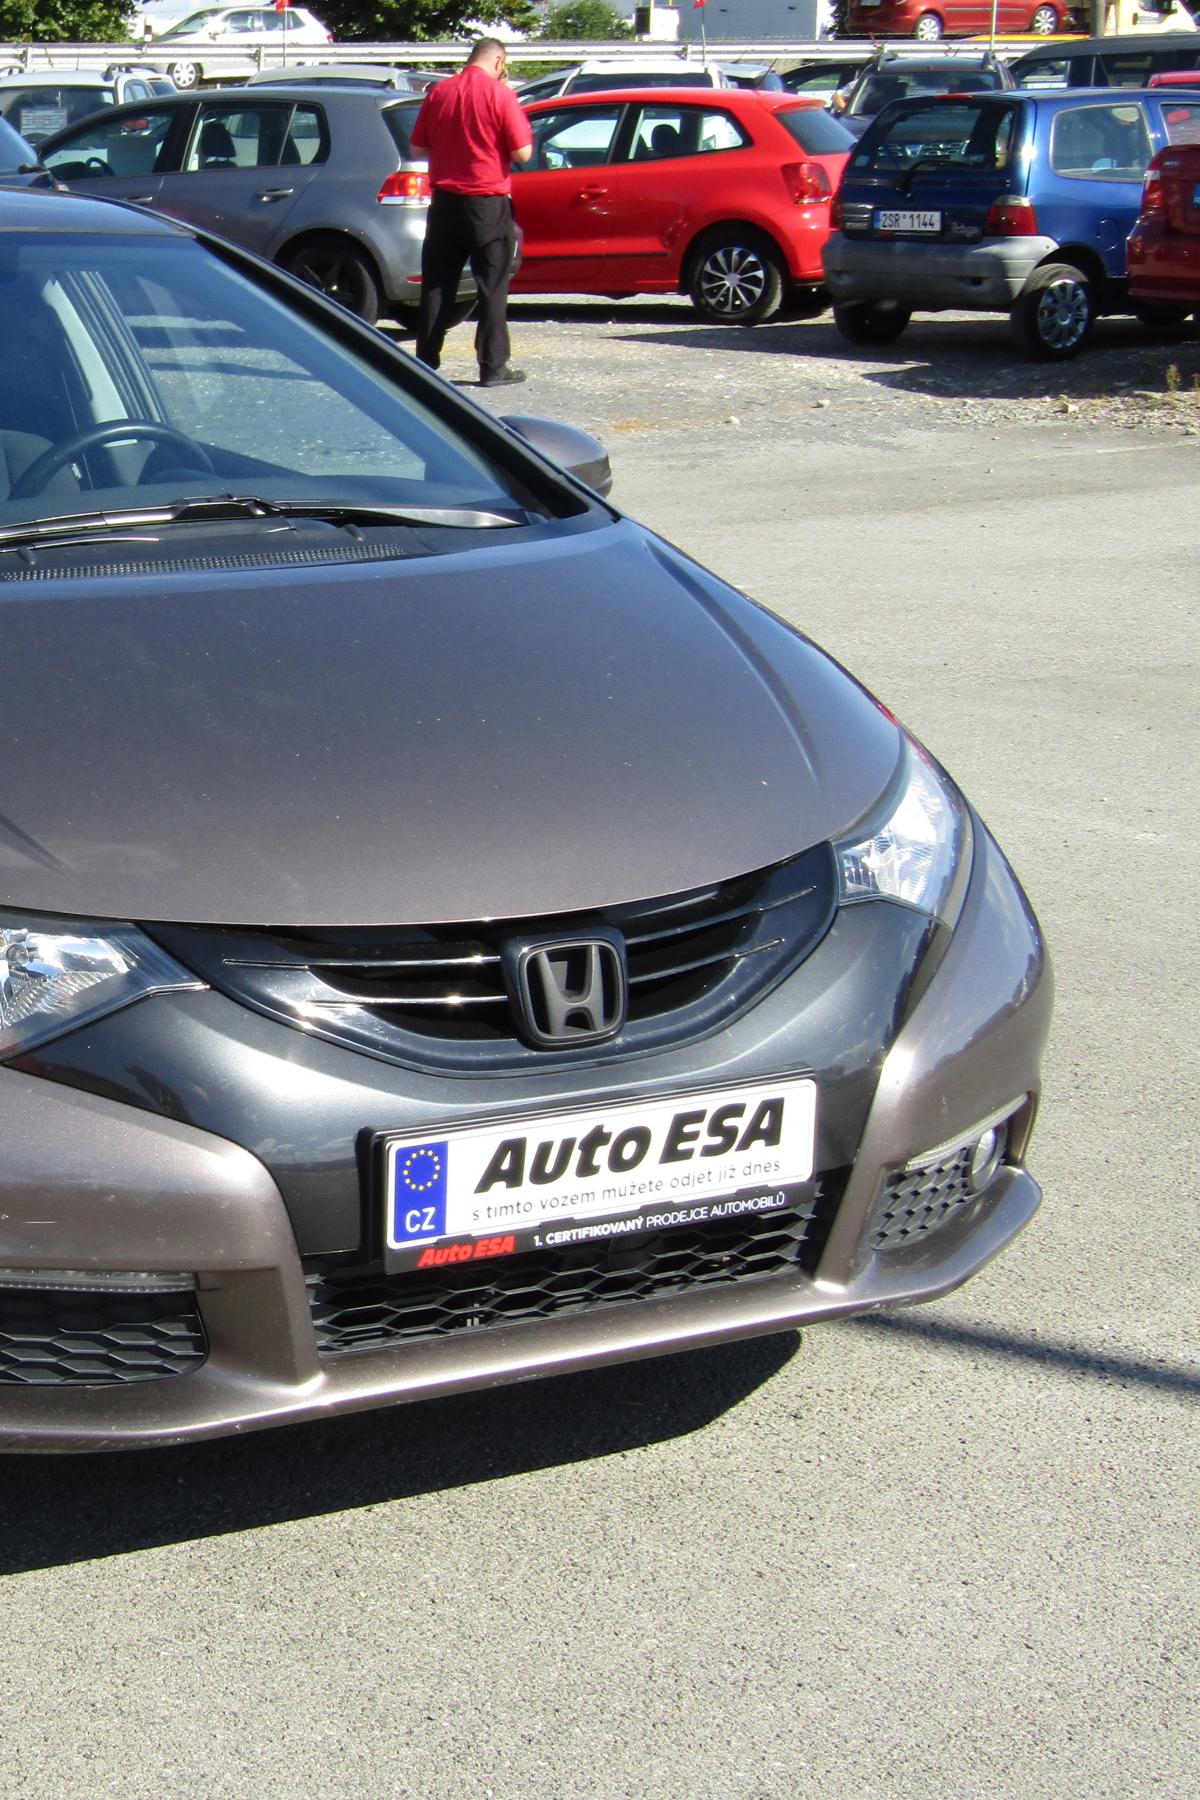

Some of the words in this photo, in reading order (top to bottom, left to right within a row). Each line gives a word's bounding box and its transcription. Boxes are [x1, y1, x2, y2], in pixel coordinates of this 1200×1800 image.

[881, 213, 900, 228] 2SR
[909, 213, 935, 229] 1144
[473, 1124, 652, 1194] Auto
[658, 1097, 785, 1164] ESA
[472, 1209, 480, 1221] s
[540, 1191, 596, 1210] vozem
[670, 1169, 713, 1189] odjet
[742, 1160, 781, 1177] dnes
[405, 1206, 436, 1233] CZ
[533, 1234, 543, 1247] 1.
[545, 1215, 644, 1246] CERTIFIKOVANÝ
[646, 1206, 709, 1228] PRODEJCE
[710, 1190, 786, 1217] AUTOMOBILŮ
[416, 1242, 473, 1268] Auto
[473, 1235, 516, 1258] ESA
